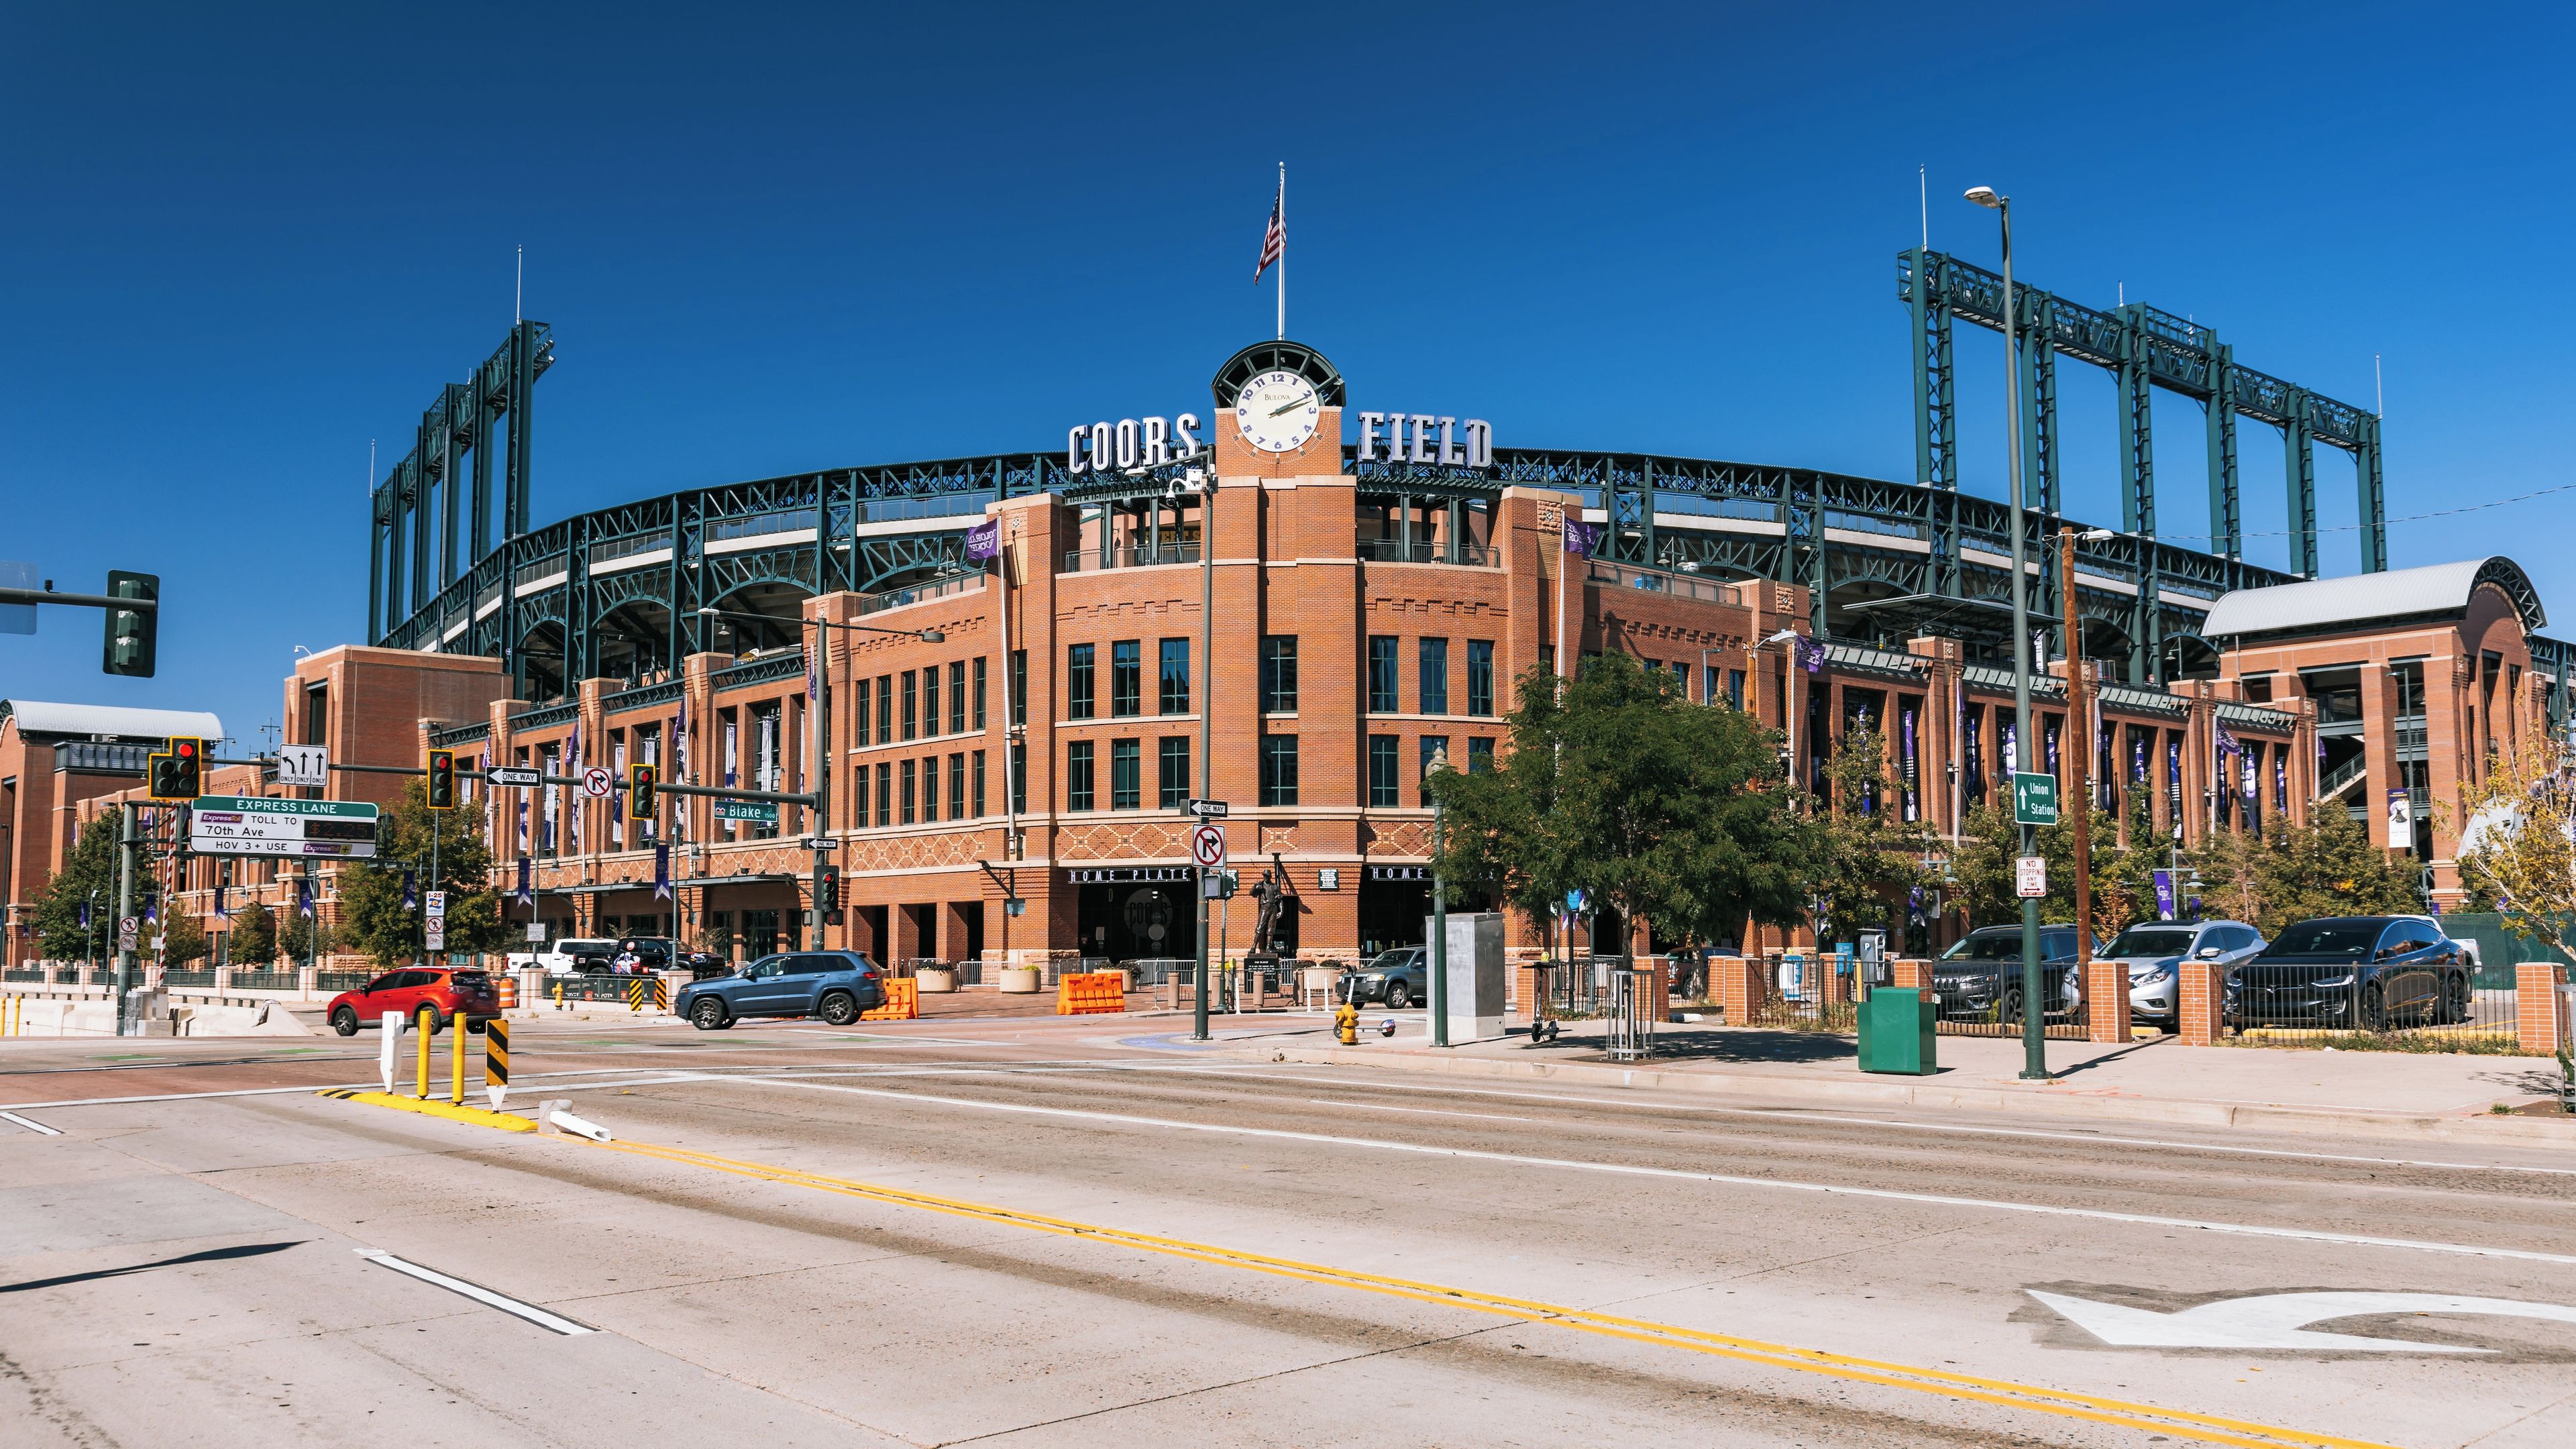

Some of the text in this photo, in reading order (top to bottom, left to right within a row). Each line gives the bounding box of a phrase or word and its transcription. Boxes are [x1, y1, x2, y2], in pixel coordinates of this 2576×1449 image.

[1254, 378, 1266, 388] 11
[1271, 374, 1285, 382] 12
[1291, 378, 1299, 386] 1
[1242, 389, 1253, 400] 10
[1303, 390, 1312, 399] 2
[1239, 408, 1247, 416] 9
[1243, 425, 1252, 433] 8
[1303, 425, 1312, 433] 4
[1069, 412, 1492, 474] COORS FIELD
[1256, 436, 1266, 444] 7
[1274, 441, 1282, 449] 6
[1291, 436, 1299, 445] 5
[2029, 782, 2049, 795] Union
[237, 800, 337, 814] EXPRESS LANE
[729, 805, 761, 818] Blake
[2031, 802, 2055, 816] Station
[203, 814, 242, 823] ExpressToll
[251, 816, 277, 824] TOLL
[205, 825, 264, 837] 70th Ave
[216, 841, 238, 849] HOV
[305, 844, 340, 853] ExpressToll
[1071, 869, 1187, 882] HOME PLATE
[1373, 867, 1423, 879] HOME
[2020, 868, 2043, 876] STOPPING
[2157, 885, 2171, 901] CR
